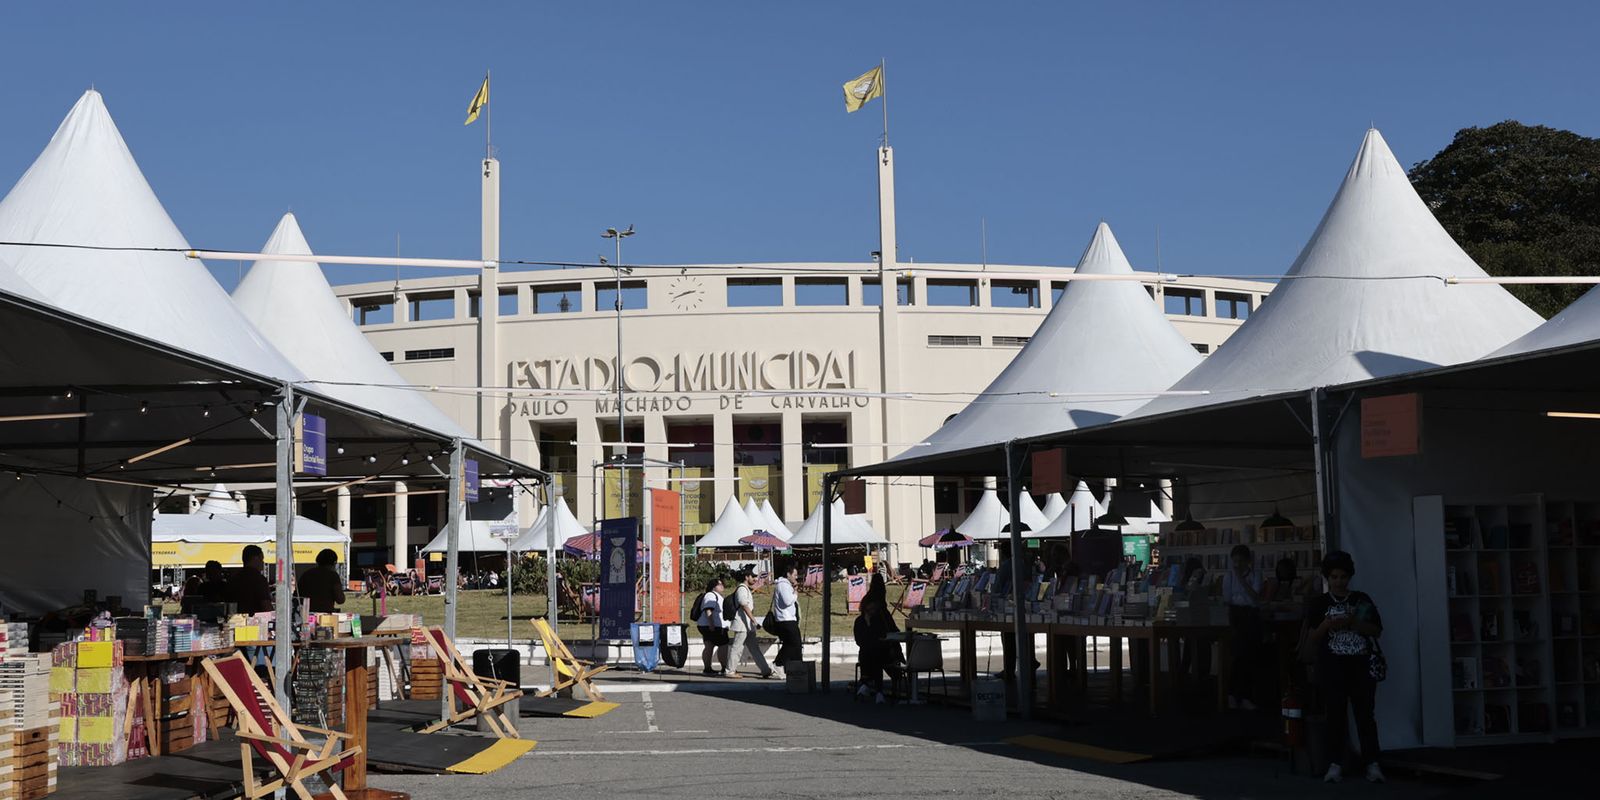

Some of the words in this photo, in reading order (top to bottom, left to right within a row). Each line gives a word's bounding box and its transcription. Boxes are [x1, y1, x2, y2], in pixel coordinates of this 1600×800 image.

[509, 400, 568, 416] PAULO
[595, 395, 691, 414] MACHADO
[720, 394, 742, 410] DE
[770, 394, 870, 410] CARVALHO
